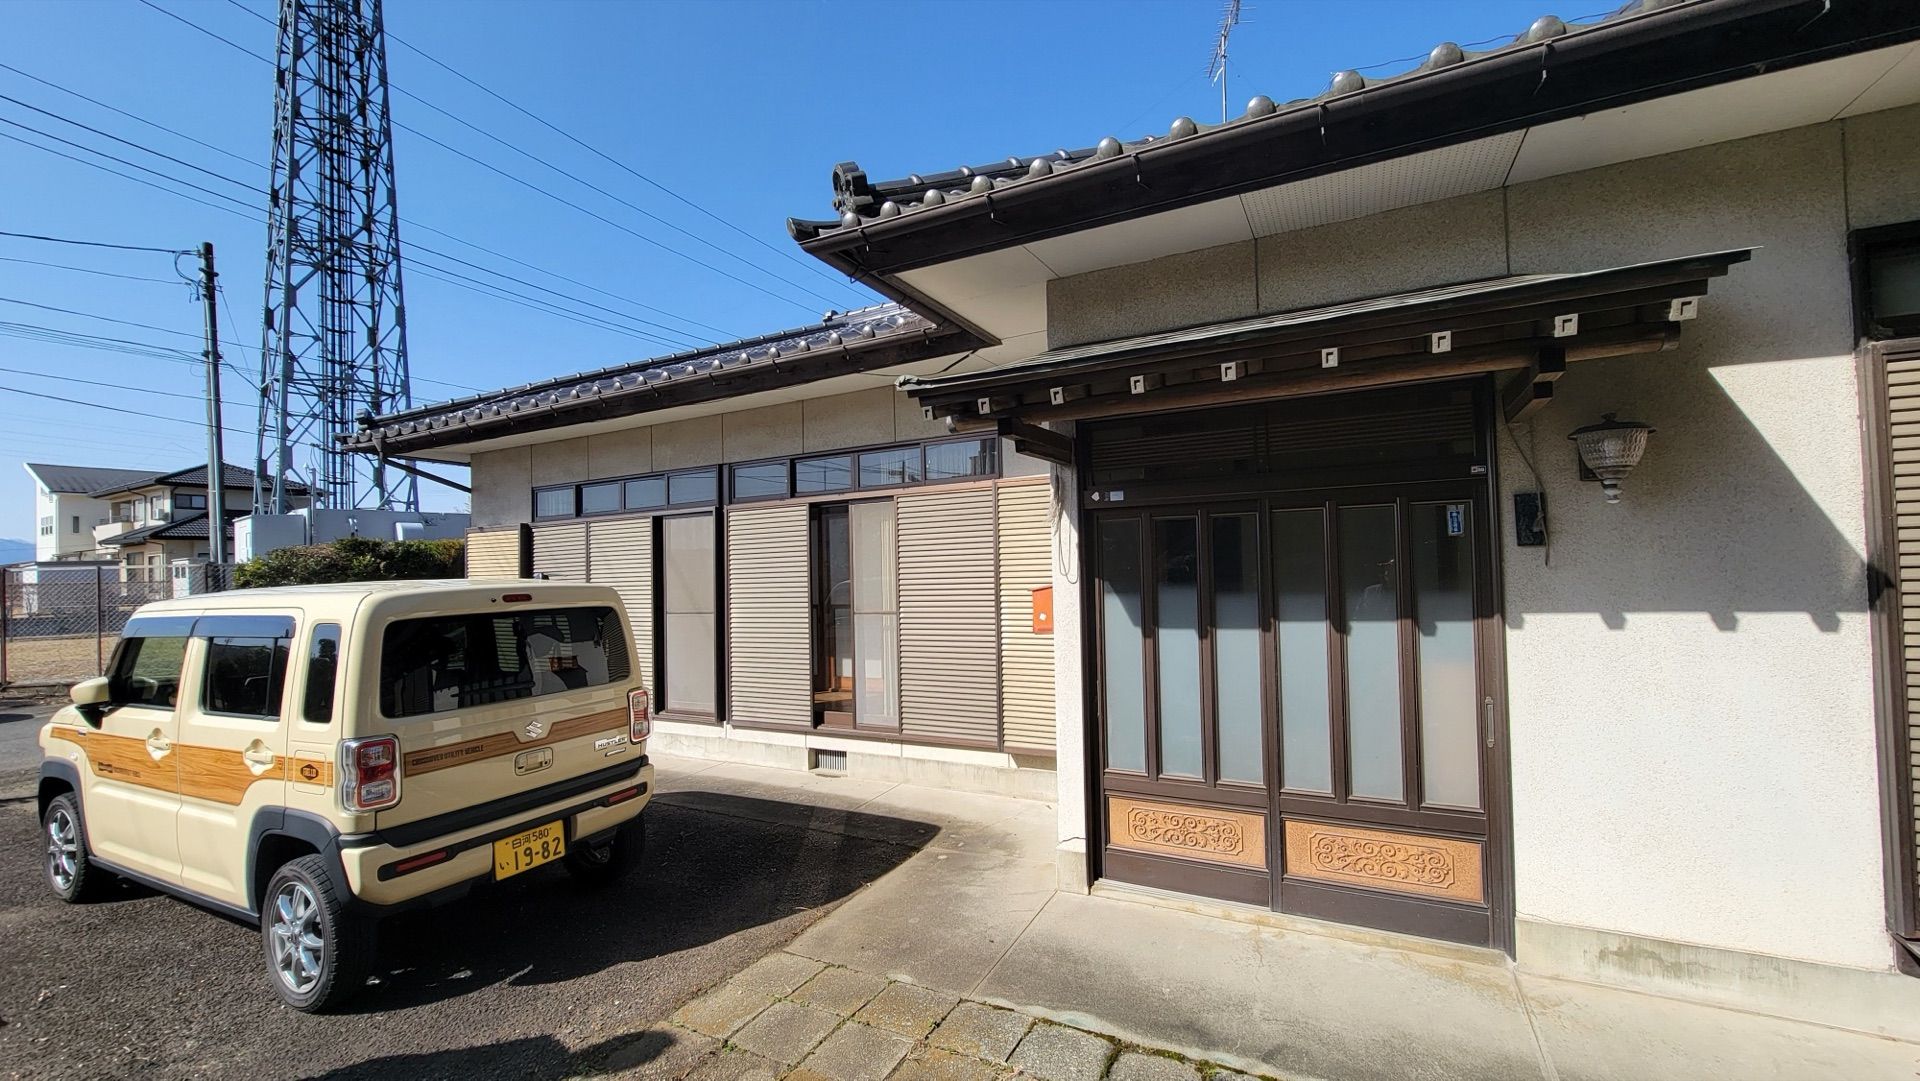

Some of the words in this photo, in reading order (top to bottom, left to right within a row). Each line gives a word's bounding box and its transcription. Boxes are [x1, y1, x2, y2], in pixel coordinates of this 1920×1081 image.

[597, 736, 627, 748] HUSTLER
[499, 861, 510, 871] い
[514, 836, 562, 871] 19-82
